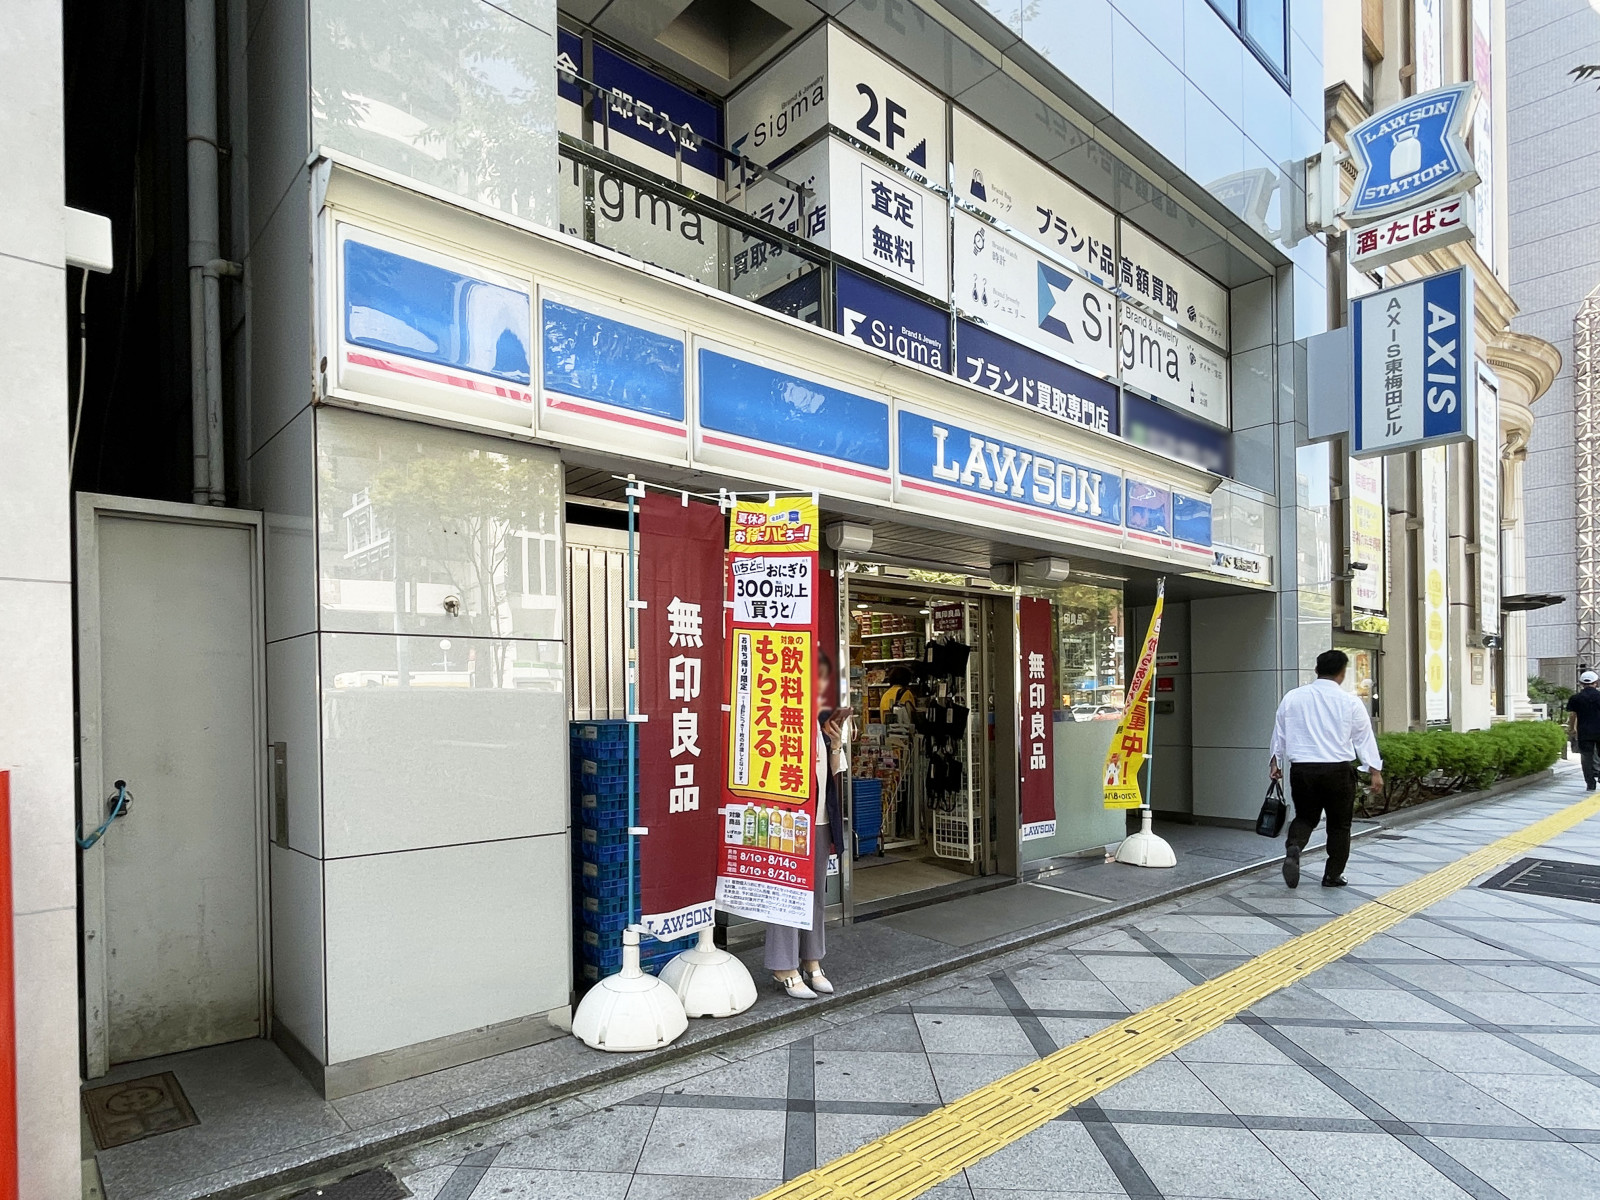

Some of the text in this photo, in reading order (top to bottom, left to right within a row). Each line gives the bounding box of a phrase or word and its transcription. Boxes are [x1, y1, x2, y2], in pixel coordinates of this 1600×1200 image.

[753, 85, 824, 147] Sigma
[855, 82, 907, 151] 2F
[1364, 102, 1449, 144] LAWSON
[557, 155, 706, 245] igma
[871, 179, 914, 229] 査定
[1365, 159, 1450, 200] STATION
[872, 224, 915, 273] 無料
[1357, 202, 1460, 255] 酒・たばこ
[871, 320, 942, 369] Sigma
[901, 326, 918, 340] Brand
[922, 335, 942, 349] Jewelry
[1082, 292, 1180, 382] Sigma
[1126, 306, 1147, 328] Brand
[1154, 324, 1179, 347] Jewelry
[1384, 297, 1403, 437] AXIS東梅田ビル
[1427, 302, 1457, 414] AXIS
[966, 357, 1109, 433] ブランド買取専門店
[932, 425, 1102, 517] LAWSON
[737, 512, 766, 525] 夏休み
[734, 560, 763, 574] いちどに
[737, 579, 808, 598] 300円以上
[767, 563, 808, 578] おにぎり
[752, 601, 790, 619] 買うと
[781, 636, 803, 645] 対象の
[667, 596, 704, 814] 無印良品
[754, 635, 778, 788] もらえる!
[780, 647, 804, 792] 飲料無料券
[1028, 651, 1046, 770] 無印良品
[1024, 823, 1055, 837] LAWSON
[647, 906, 713, 936] LAWSON
